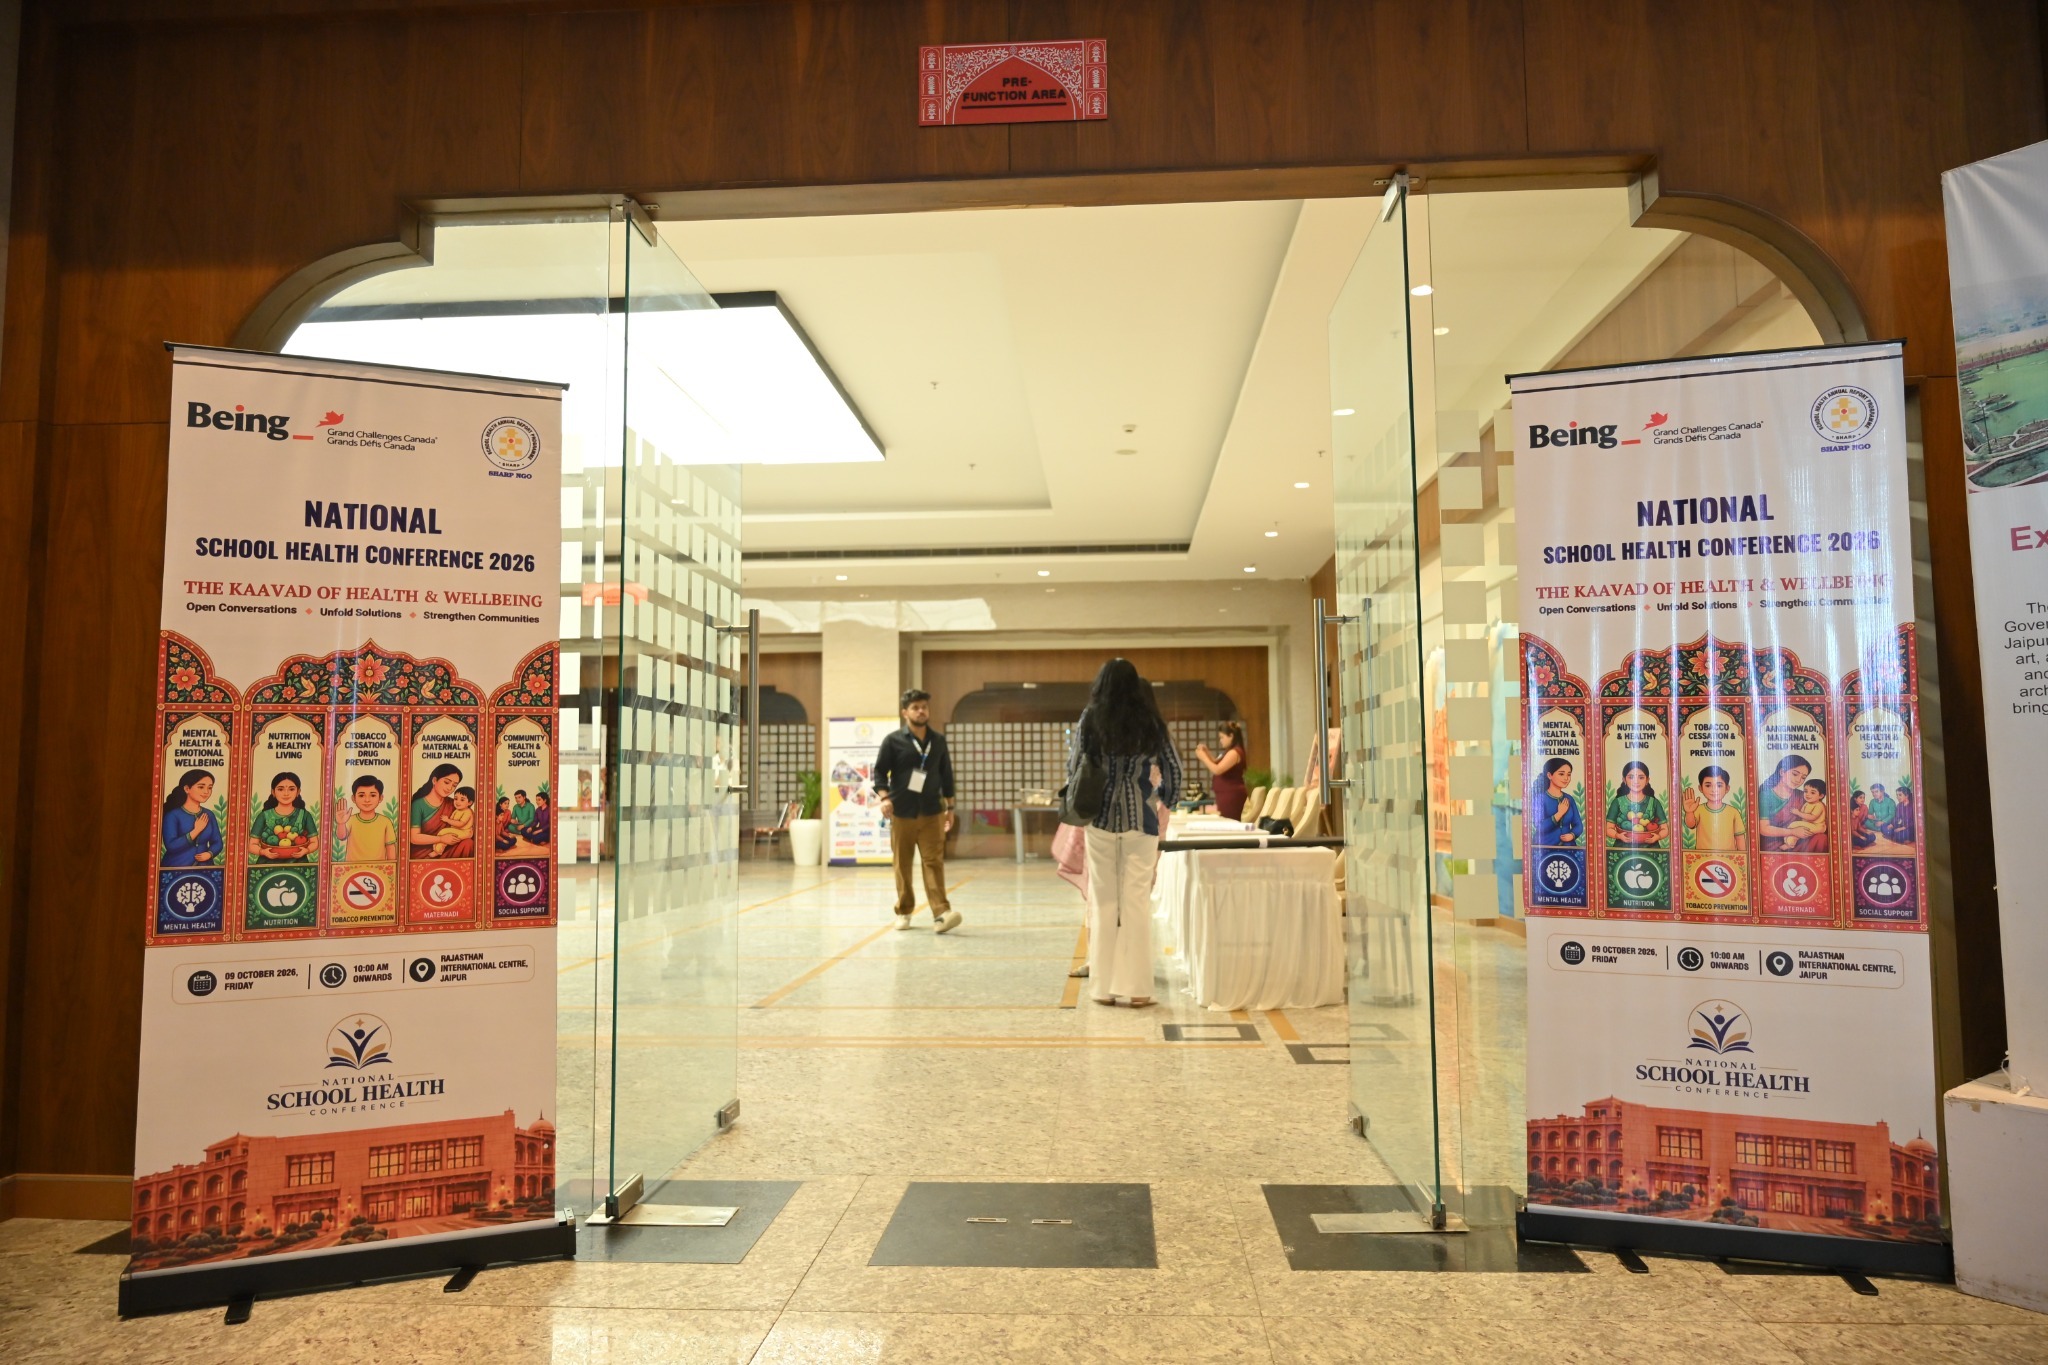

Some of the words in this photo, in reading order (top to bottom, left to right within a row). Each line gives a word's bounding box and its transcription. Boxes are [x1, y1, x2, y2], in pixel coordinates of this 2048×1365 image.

[1003, 77, 1032, 87] PRE-
[963, 90, 1026, 102] FUNCTION
[1031, 89, 1066, 100] AREA
[187, 401, 290, 441] Being
[1680, 425, 1726, 434] Challenges
[327, 428, 354, 438] Grand
[356, 430, 402, 442] Challenges
[1529, 421, 1618, 449] Being
[1685, 434, 1706, 443] Défis
[1709, 432, 1741, 440] Canada
[327, 437, 358, 446] Grands
[360, 439, 381, 448] Défis
[383, 443, 415, 451] Canada
[1637, 494, 1774, 527] NATIONAL
[304, 500, 442, 534] NATIONAL
[1543, 543, 1615, 564] SCHOOL
[1622, 539, 1690, 560] HEALTH
[1698, 533, 1821, 557] CONFERENCE
[1827, 530, 1881, 552] 2026
[195, 537, 278, 560] SCHOOL
[286, 541, 358, 564] HEALTH
[366, 545, 483, 570] CONFERENCE
[489, 552, 535, 572] 2026
[184, 581, 224, 595] THE
[229, 582, 312, 598] KAAVAD
[317, 586, 341, 599] OF
[346, 587, 418, 603] HEALTH
[425, 591, 438, 603] &
[444, 591, 543, 607] WELLBEING
[1536, 586, 1569, 599] THE
[1574, 583, 1648, 597] KAAVAD
[1653, 582, 1676, 595] OF
[1681, 579, 1754, 594] HEALTH
[1760, 579, 1775, 591] &
[186, 602, 215, 613] Open
[219, 603, 297, 614] Conversations
[1539, 606, 1564, 616] Open
[1566, 604, 1636, 614] Conversations
[1657, 602, 1689, 611] Unfold
[1692, 601, 1737, 609] Solutions
[320, 608, 353, 617] Unfold
[356, 609, 402, 618] Solutions
[423, 611, 476, 622] Strengthen
[478, 614, 539, 623] Communities
[2016, 652, 2040, 664] art,
[182, 730, 218, 738] MENTAL
[179, 739, 212, 747] HEALTH
[276, 742, 311, 750] HEALTHY
[1538, 739, 1579, 747] EMOTIONAL
[174, 749, 224, 757] EMOTIONAL
[1538, 748, 1580, 756] WELLBEING
[174, 758, 224, 767] WELLBEING
[1686, 902, 1712, 910] TOBACCO
[264, 918, 298, 926] NUTRITION
[360, 914, 394, 922] PREVENTION
[164, 923, 189, 931] MENTAL
[1603, 946, 1636, 955] OCTOBER
[1638, 948, 1658, 956] 2026,
[1710, 951, 1731, 959] 10:00
[1732, 952, 1744, 960] AM
[1799, 951, 1844, 960] RAJASTHAN
[441, 953, 483, 962] RAJASTHAN
[1592, 955, 1618, 963] FRIDAY
[376, 963, 389, 971] AM
[441, 962, 496, 972] INTERNATIONAL
[499, 960, 528, 968] CENTRE,
[1710, 962, 1749, 970] ONWARDS
[1799, 961, 1860, 971] INTERNATIONAL
[1862, 964, 1896, 974] CENTRE,
[225, 972, 235, 980] 09
[238, 970, 274, 979] OCTOBER
[276, 969, 298, 977] 2026,
[353, 973, 392, 982] ONWARDS
[440, 974, 467, 982] JAIPUR
[1799, 971, 1828, 979] JAIPUR
[224, 982, 254, 990] FRIDAY
[1685, 1058, 1756, 1070] NATIONAL
[322, 1074, 394, 1086] NATIONAL
[1636, 1065, 1720, 1086] SCHOOL
[1726, 1071, 1810, 1092] HEALTH
[267, 1087, 357, 1110] SCHOOL
[362, 1079, 445, 1101] HEALTH
[1676, 1085, 1768, 1099] CONFERENCE
[310, 1100, 405, 1116] CONFERENCE
